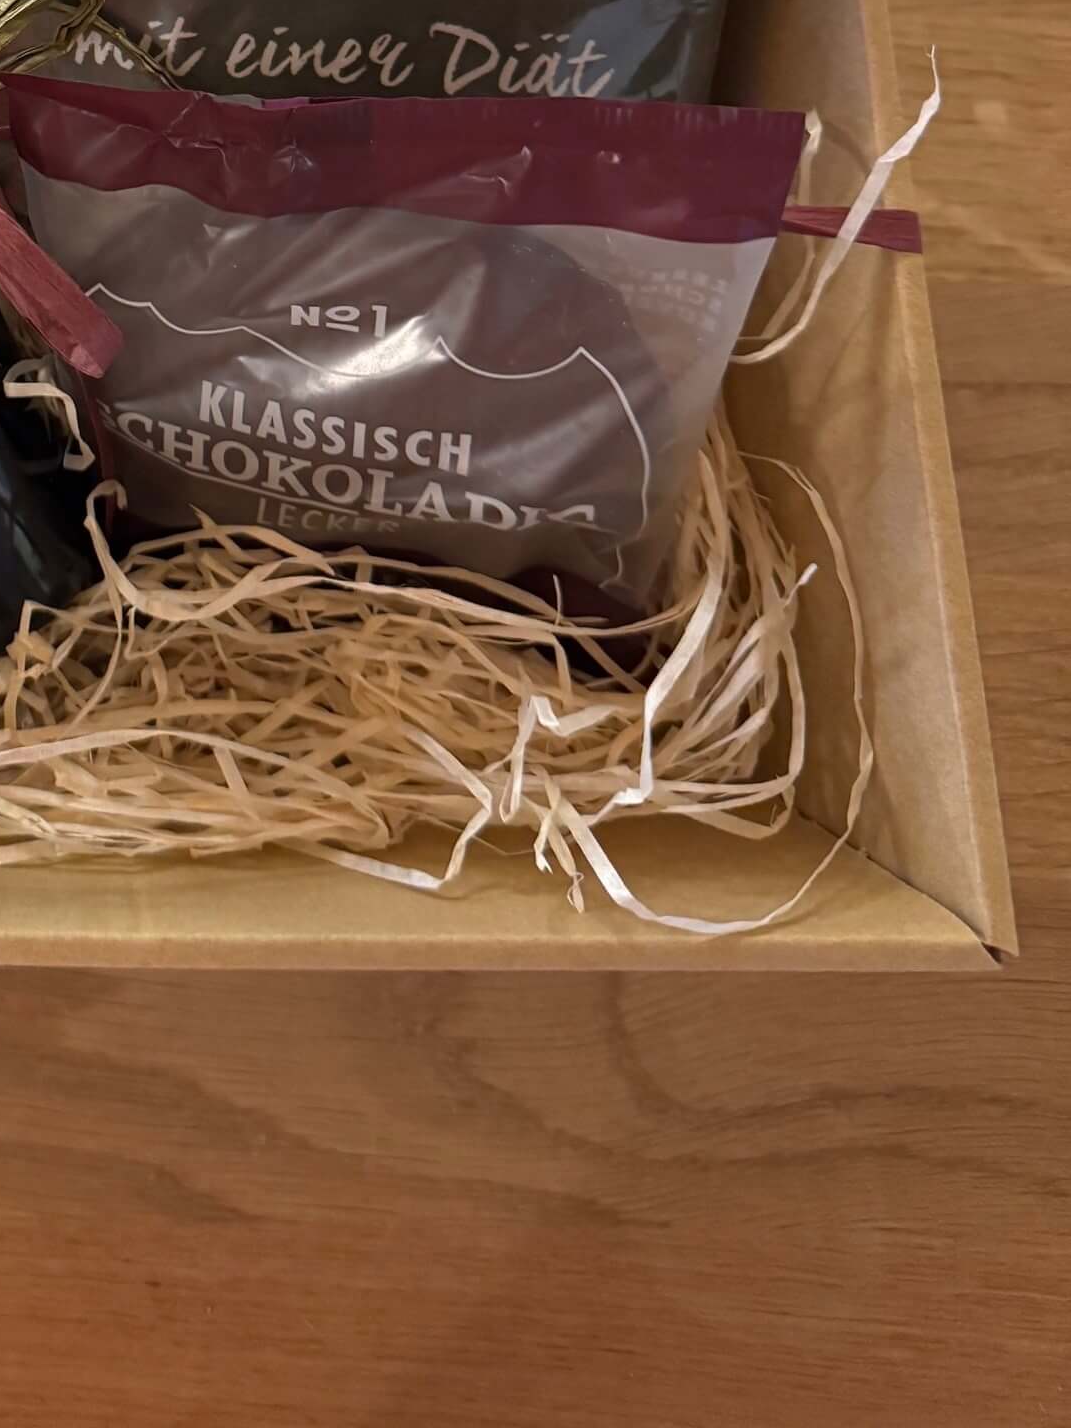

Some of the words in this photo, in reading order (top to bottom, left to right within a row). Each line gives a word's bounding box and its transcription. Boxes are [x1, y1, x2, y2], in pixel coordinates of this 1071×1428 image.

[227, 30, 415, 88] einer
[429, 22, 615, 100] Diät
[97, 399, 596, 532] CHOKOLADI
[198, 379, 473, 477] KLASSISCH
